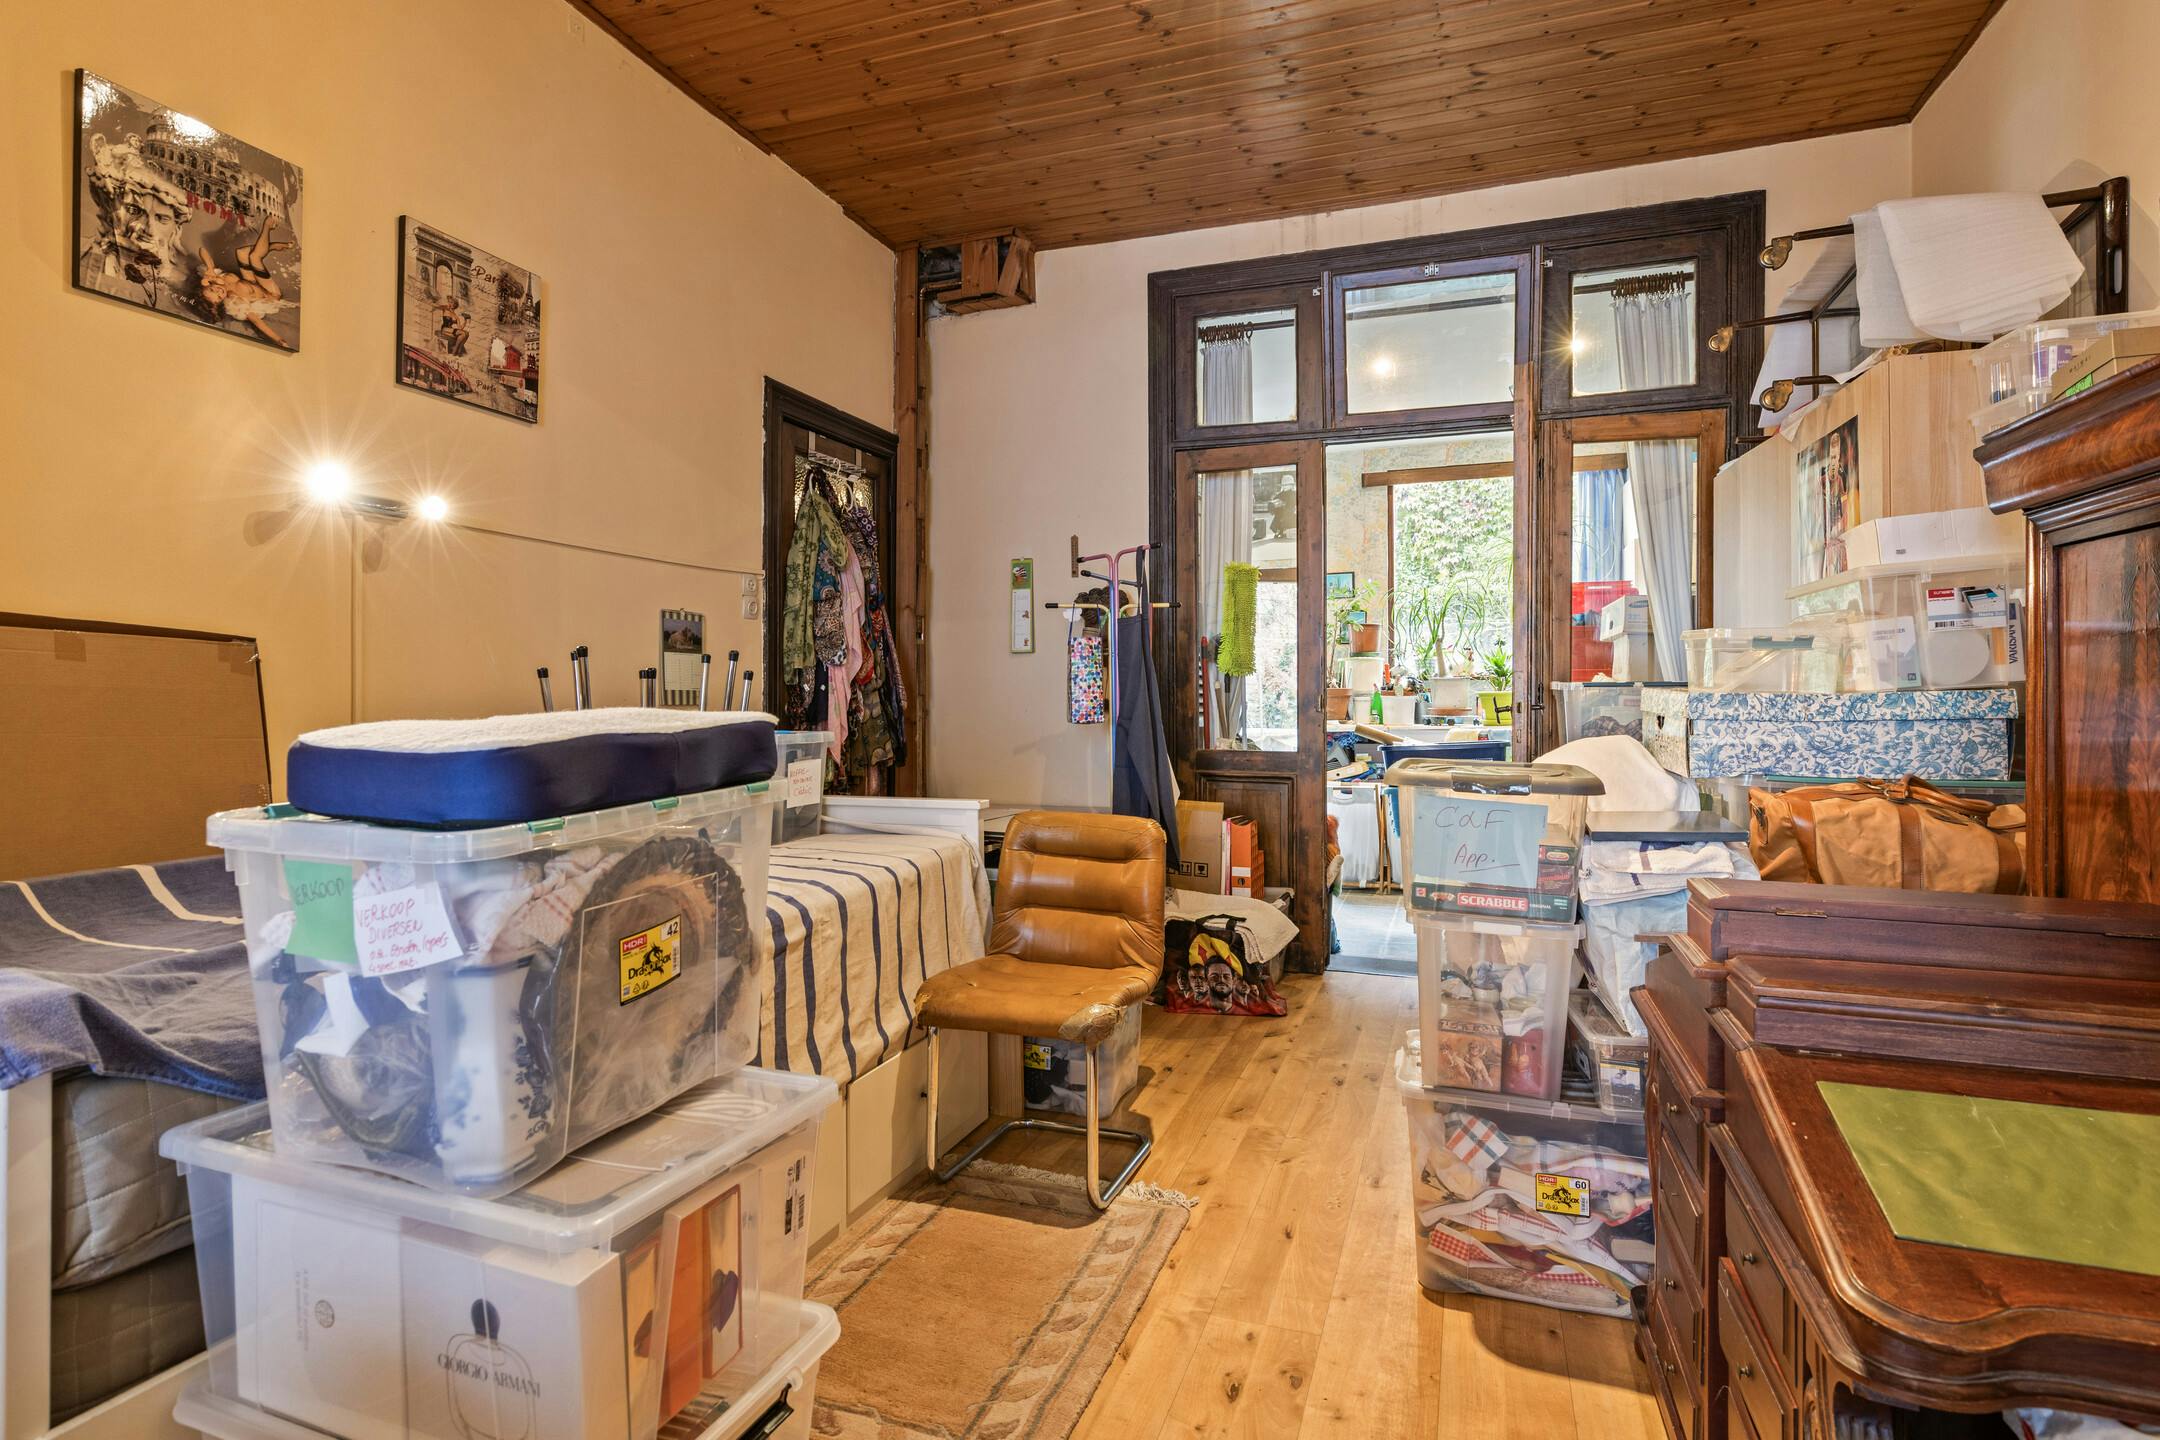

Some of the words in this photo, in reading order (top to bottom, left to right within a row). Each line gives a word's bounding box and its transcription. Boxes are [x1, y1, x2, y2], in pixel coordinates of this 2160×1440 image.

[186, 191, 246, 227] ROMA
[1453, 843, 1495, 868] App.
[1459, 895, 1525, 909] SCRABBLE
[368, 919, 424, 944] DIVERSEN
[667, 921, 679, 937] 42
[1575, 1180, 1587, 1190] 60
[438, 1353, 489, 1382] GIORGIO
[494, 1370, 541, 1398] ARMANI
